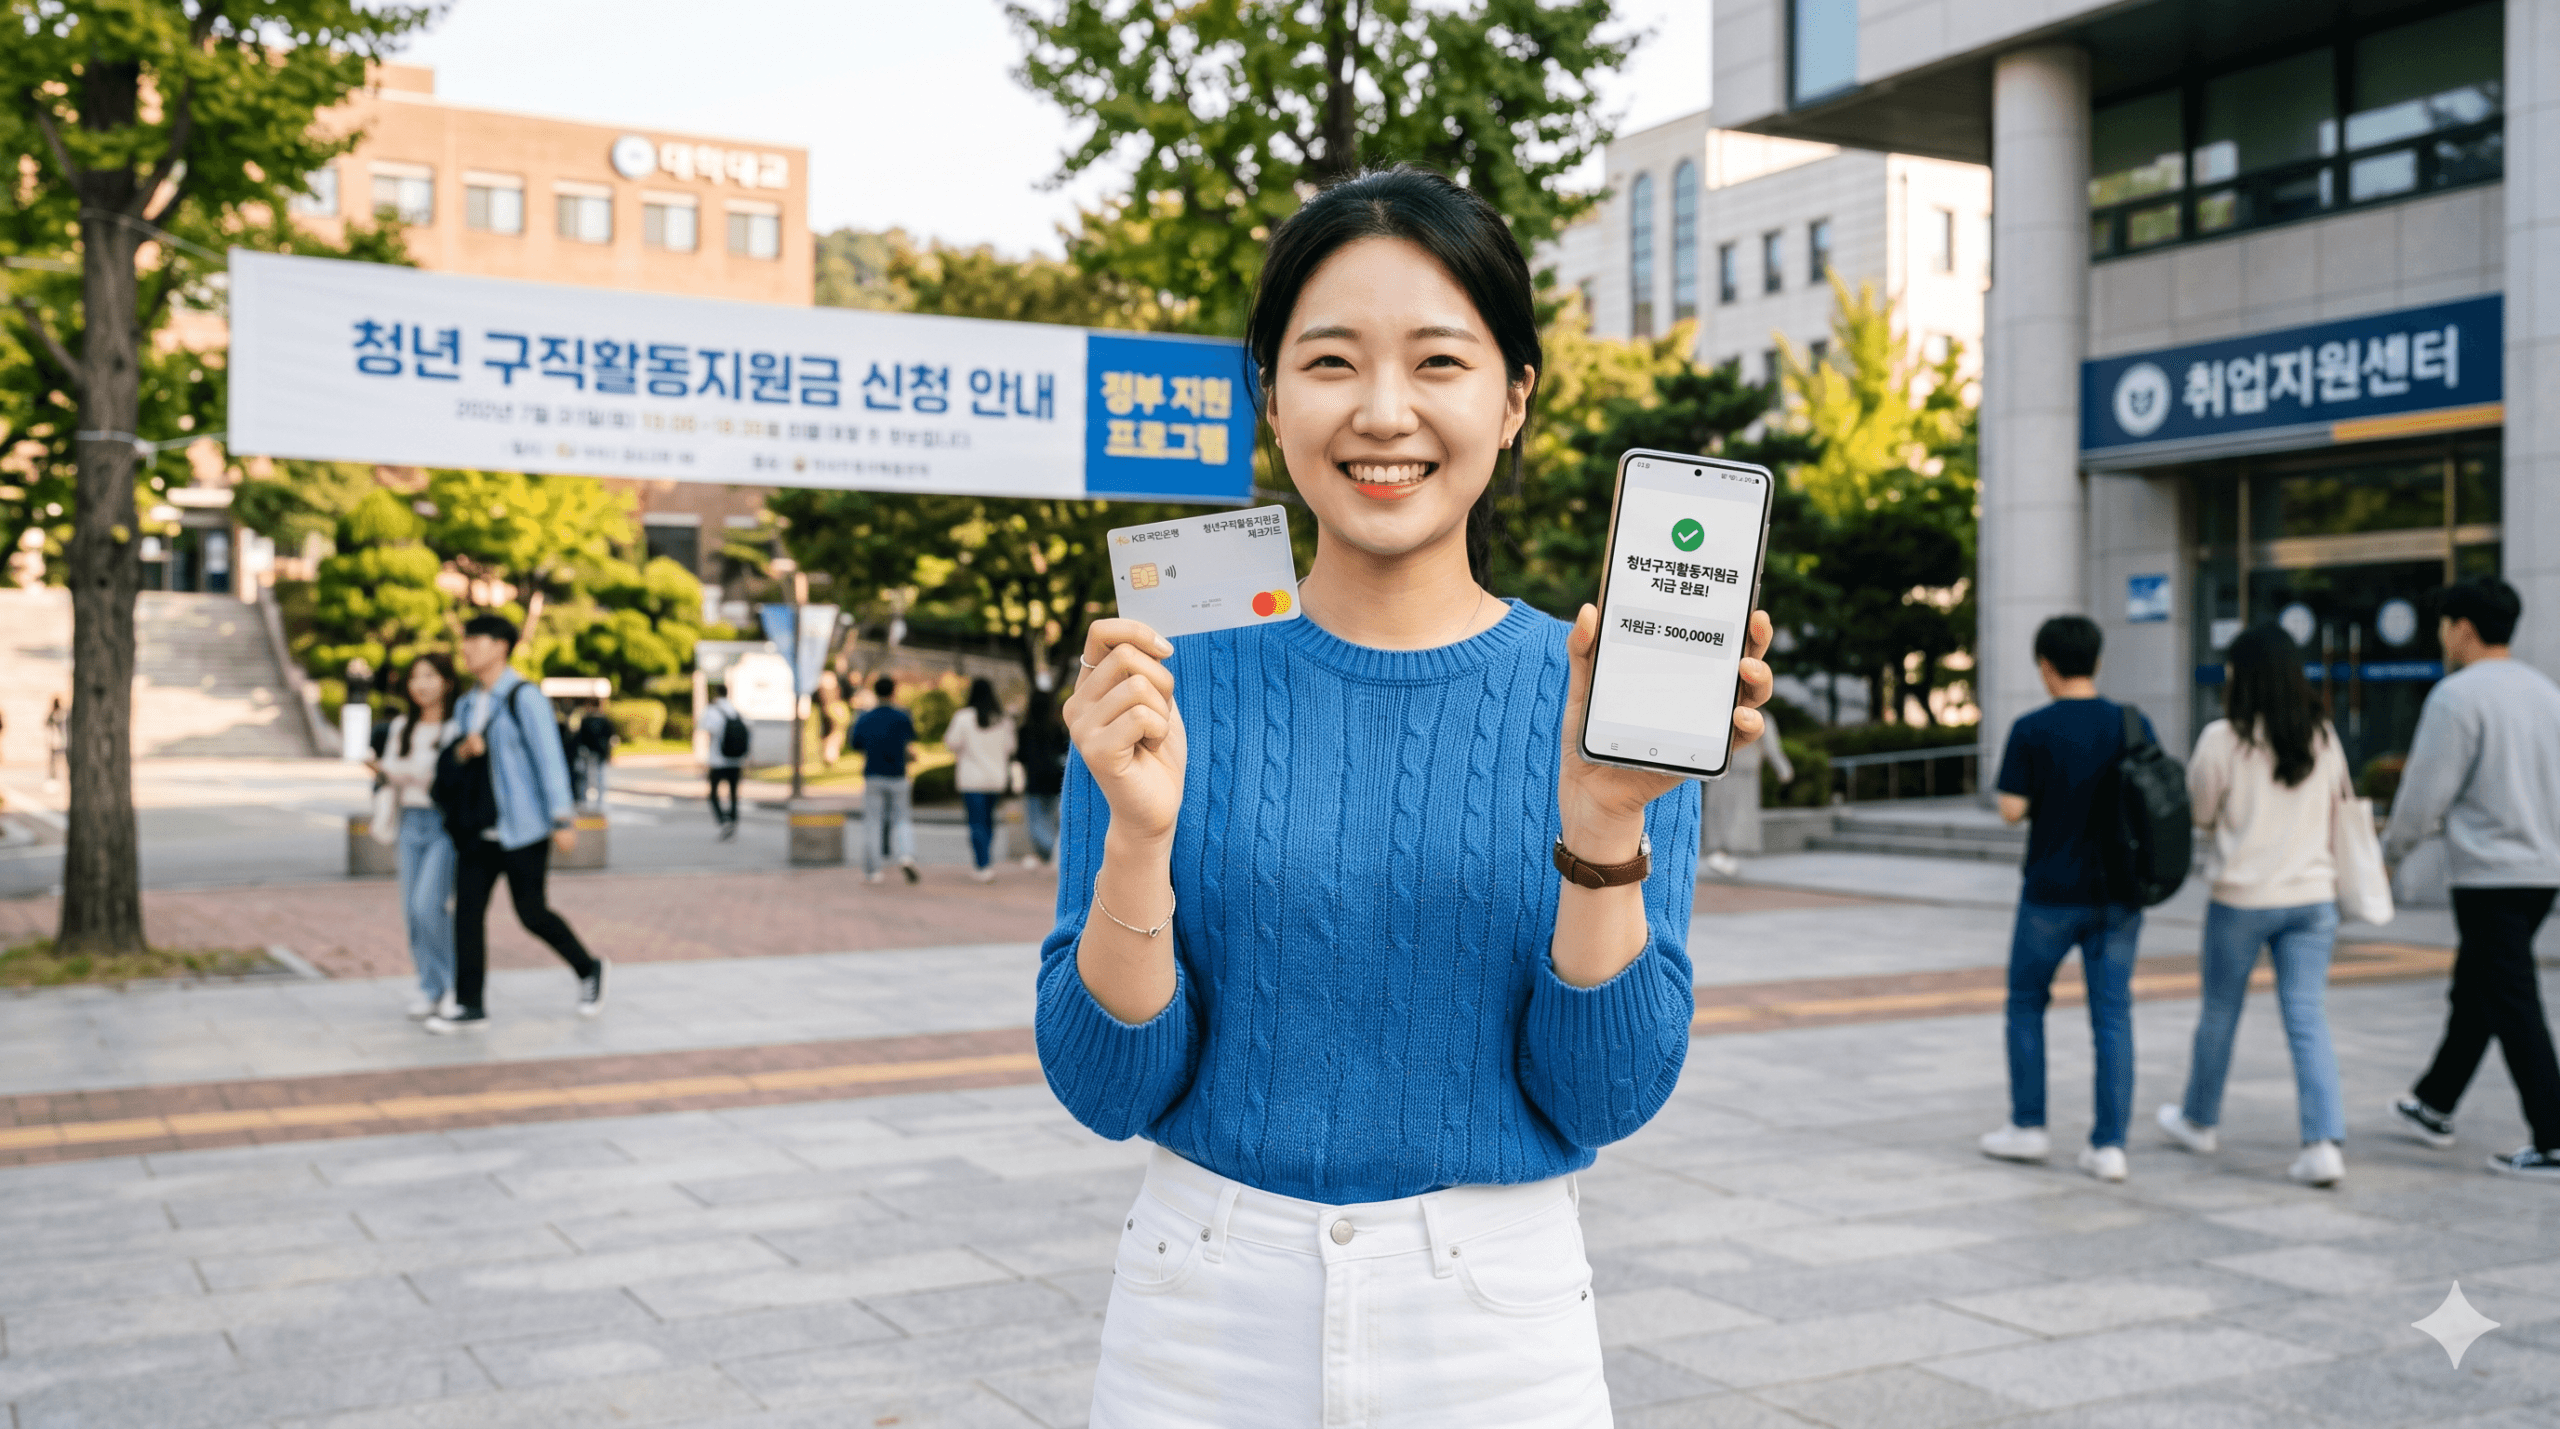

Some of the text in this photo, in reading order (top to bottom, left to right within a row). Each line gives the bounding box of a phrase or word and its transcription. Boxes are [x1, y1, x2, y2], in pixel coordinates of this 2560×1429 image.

[352, 318, 1055, 420] 청년 구직활동지원금 신청 안내
[2183, 324, 2459, 419] 취업지원센터
[1101, 371, 1232, 419] 정부 지원
[1104, 419, 1229, 465] 프로그램
[1626, 554, 1739, 584] 청년구직활동지원금
[1650, 577, 1710, 597] 지급 완료!
[1620, 618, 1656, 635] 지원금
[1664, 625, 1724, 647] 500,000원
